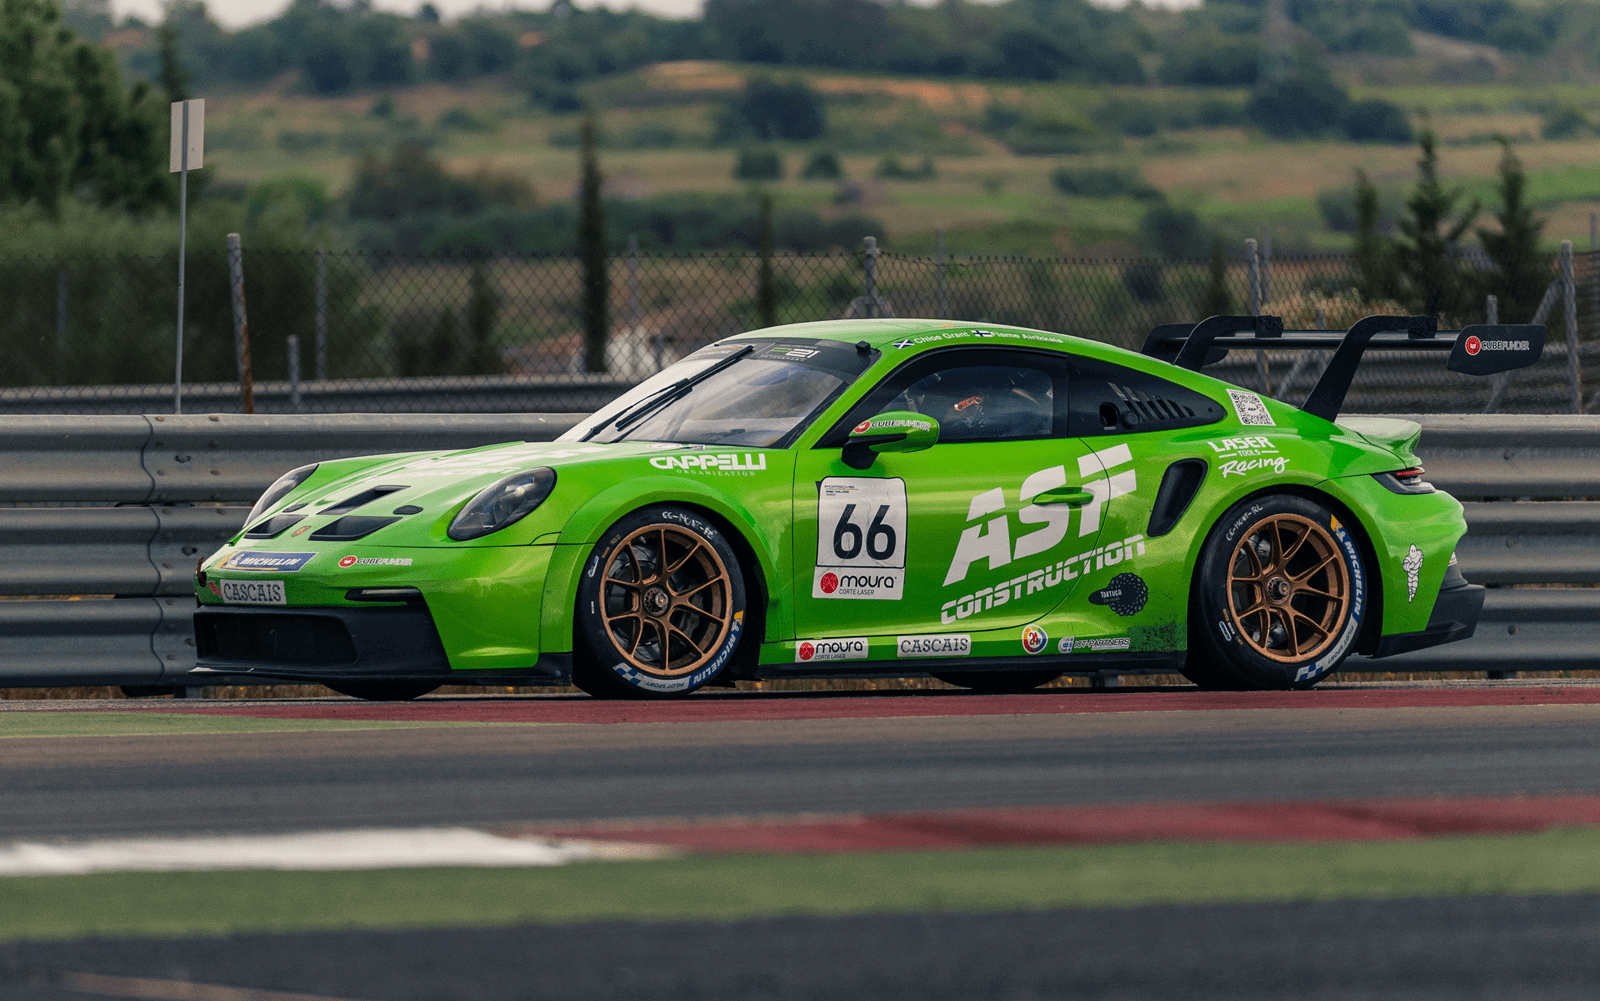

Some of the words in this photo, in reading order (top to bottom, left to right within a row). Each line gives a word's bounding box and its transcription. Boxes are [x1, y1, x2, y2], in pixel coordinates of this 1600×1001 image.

[914, 335, 942, 344] Chloe
[942, 331, 970, 339] Grant
[1481, 340, 1530, 351] CUBEFUNDER
[871, 419, 931, 432] CUBEFUNDER
[1207, 436, 1276, 453] LASER
[1236, 449, 1261, 457] TOOLS
[649, 453, 767, 470] CAPPELLI
[1218, 456, 1290, 479] Racing
[675, 468, 756, 477] ORGANIZATION
[942, 444, 1137, 587] ASF
[833, 504, 896, 560] 66
[242, 557, 302, 566] MICHELIN
[839, 575, 895, 588] moura
[940, 534, 1146, 625] CONSTRUCTION
[1344, 541, 1363, 614] MICHELIN
[223, 583, 282, 602] CASCAIS
[857, 588, 875, 596] LASER
[1344, 624, 1355, 645] PILOT
[815, 641, 863, 654] moura
[900, 638, 969, 654] CASCAIS
[1328, 644, 1345, 664] SPORT
[693, 633, 738, 683] MICHELIN
[646, 681, 667, 689] SPORT
